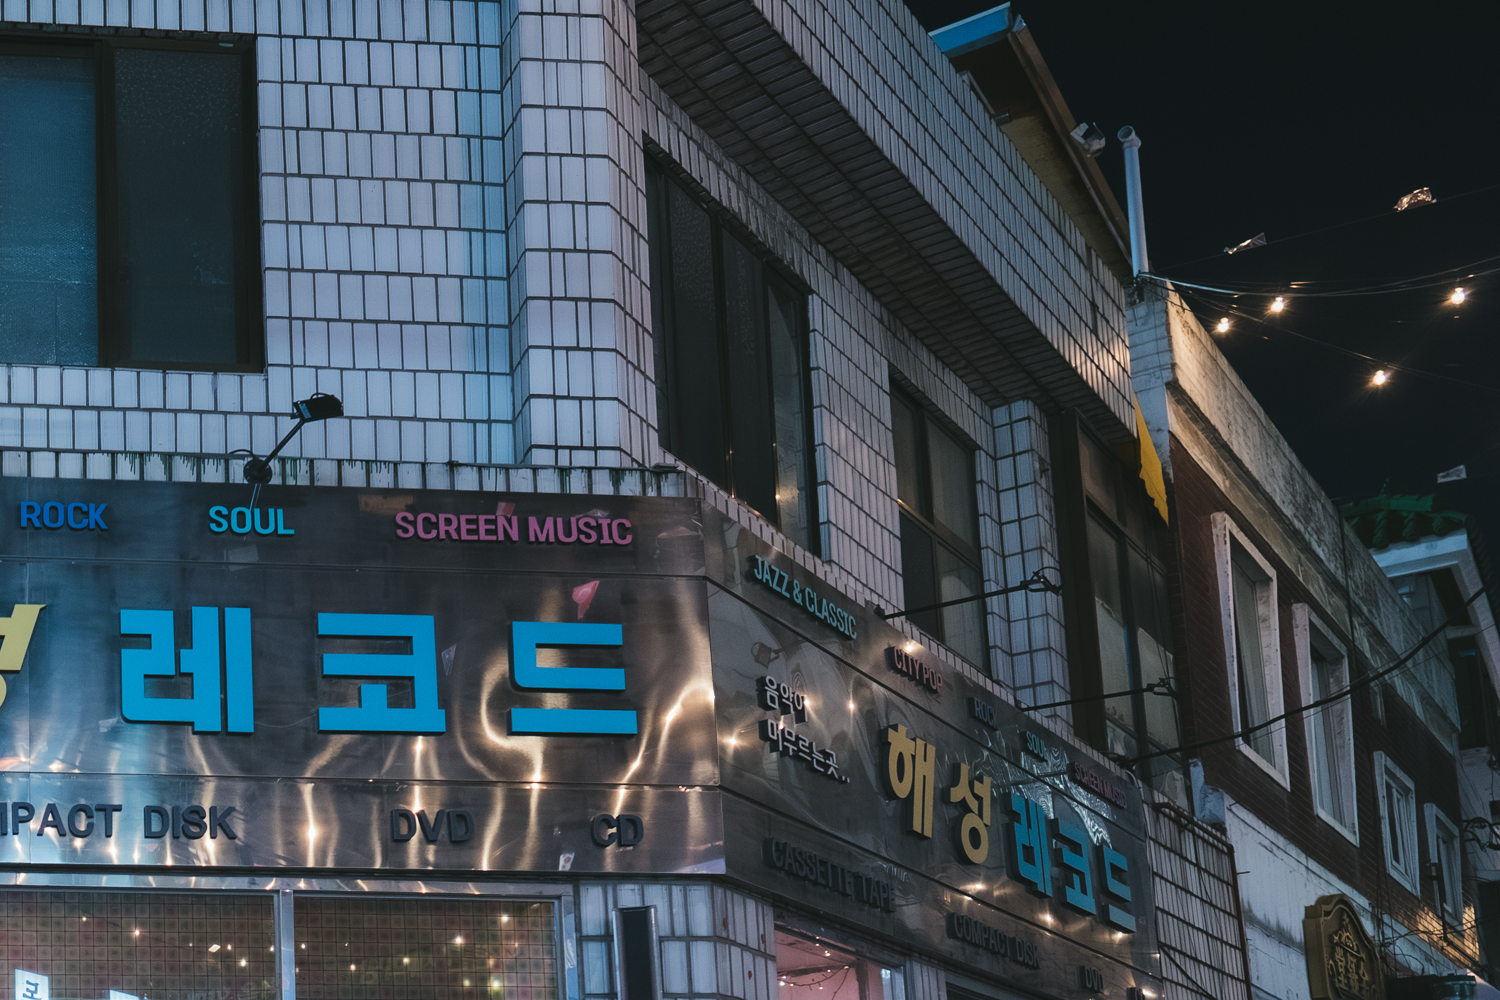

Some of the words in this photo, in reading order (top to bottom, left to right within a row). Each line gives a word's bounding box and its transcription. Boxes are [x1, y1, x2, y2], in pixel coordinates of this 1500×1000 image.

[19, 501, 108, 531] ROCK
[208, 505, 295, 536] SOUL
[395, 511, 518, 544] SCREEN
[527, 515, 633, 547] MUSIC
[752, 554, 791, 598] JAZZ
[792, 581, 804, 606] &
[804, 586, 858, 641] CLASSIC
[119, 605, 639, 735] 레코드
[892, 644, 919, 681] CITY
[920, 658, 944, 694] POP
[763, 675, 808, 724] 음악이
[973, 700, 999, 731] ROCK
[1074, 761, 1105, 793] SCREEN
[1103, 778, 1128, 809] MUSIC
[143, 805, 239, 842] DISK
[390, 808, 474, 845] DVD
[591, 813, 644, 848] CD
[888, 723, 992, 865] 해성
[1009, 791, 1138, 934] 레코드
[771, 836, 853, 896] CASSETTE
[858, 872, 896, 912] TAPE
[954, 913, 1011, 961] COMPACT
[1015, 939, 1040, 969] DISK
